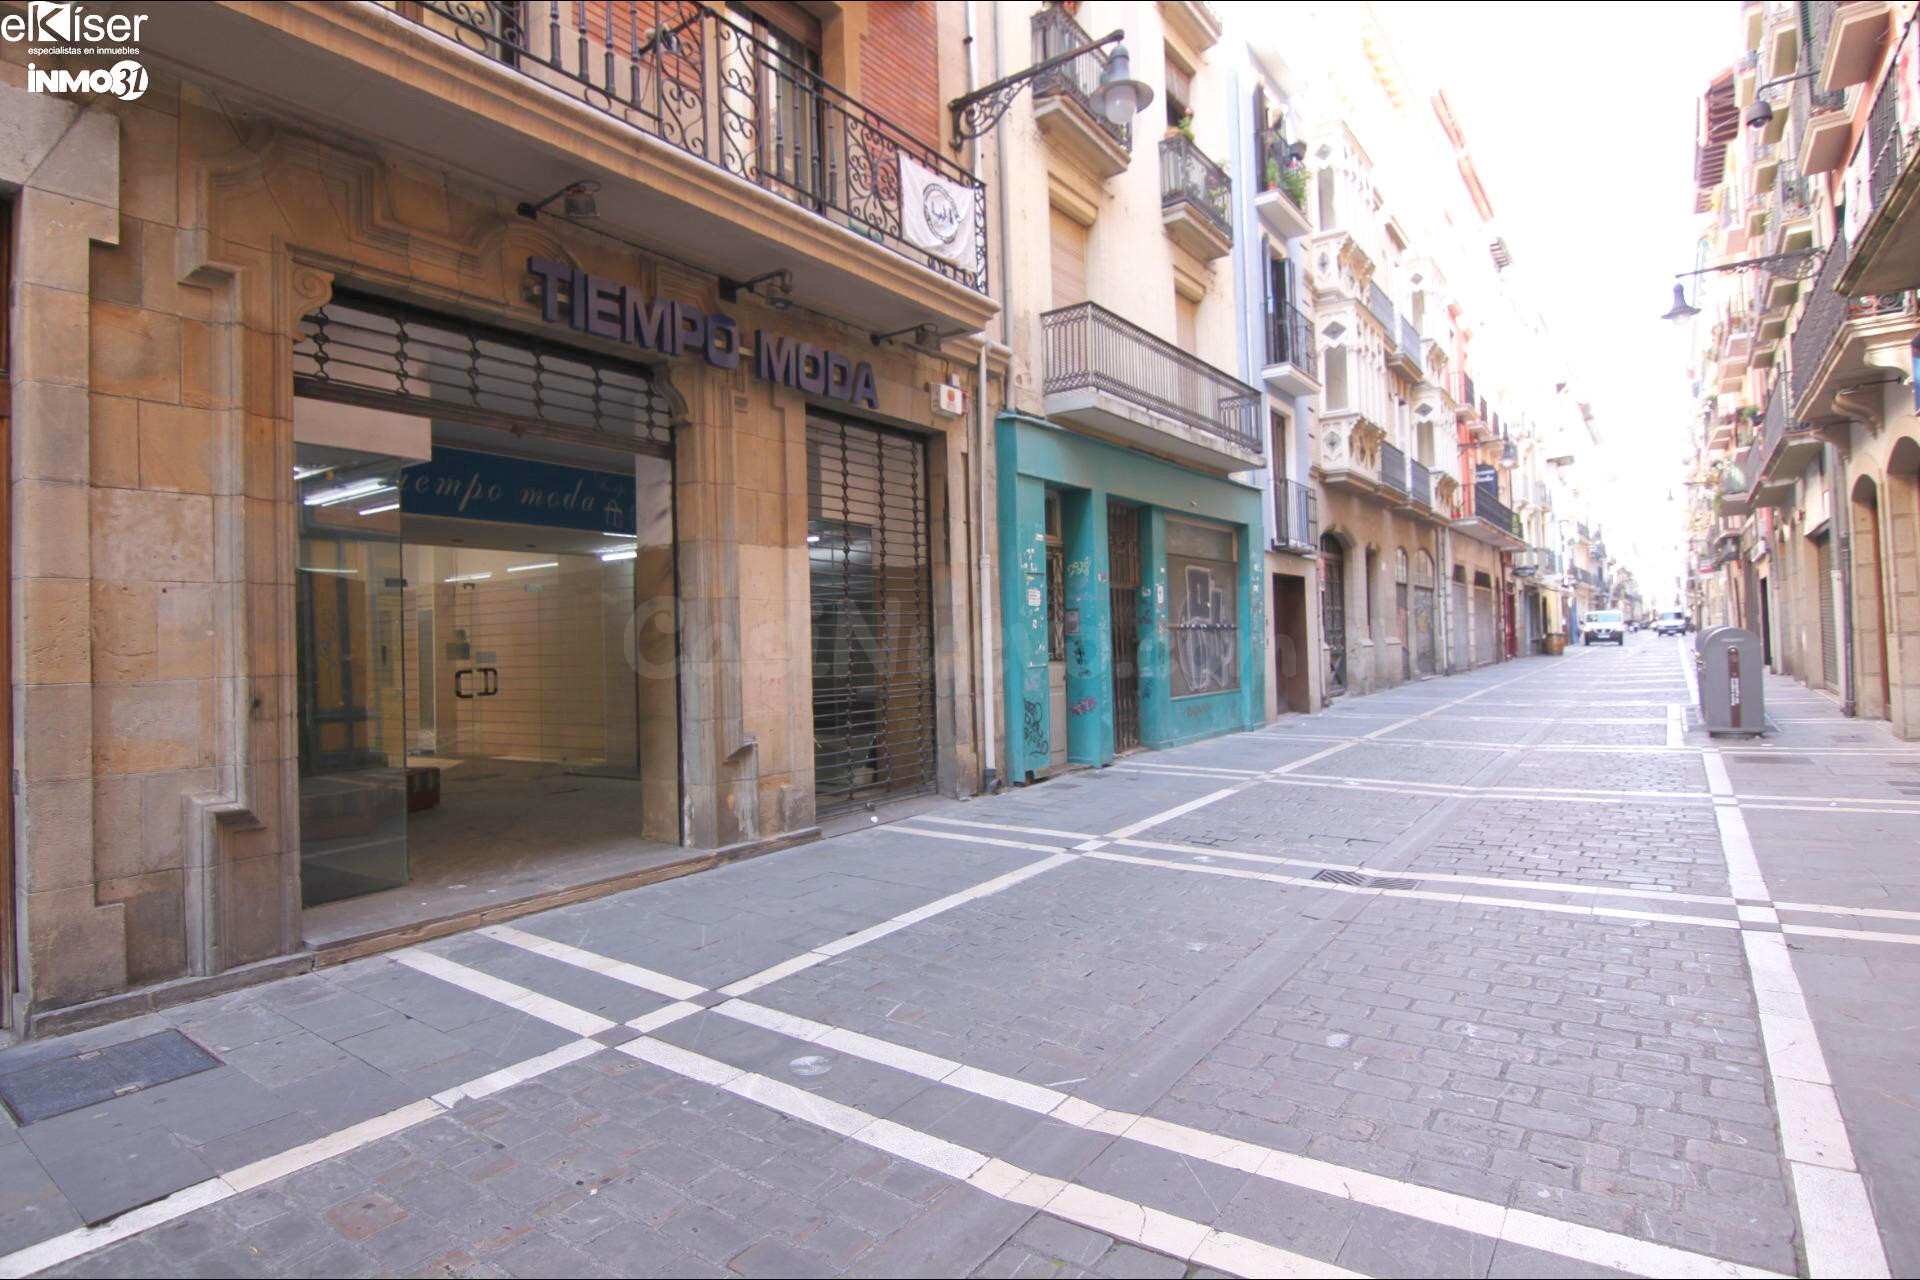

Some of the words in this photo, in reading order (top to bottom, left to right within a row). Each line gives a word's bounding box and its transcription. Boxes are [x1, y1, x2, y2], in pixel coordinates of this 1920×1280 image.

[527, 256, 740, 369] TIEMPO
[755, 329, 879, 410] MODA
[519, 479, 596, 512] moda
